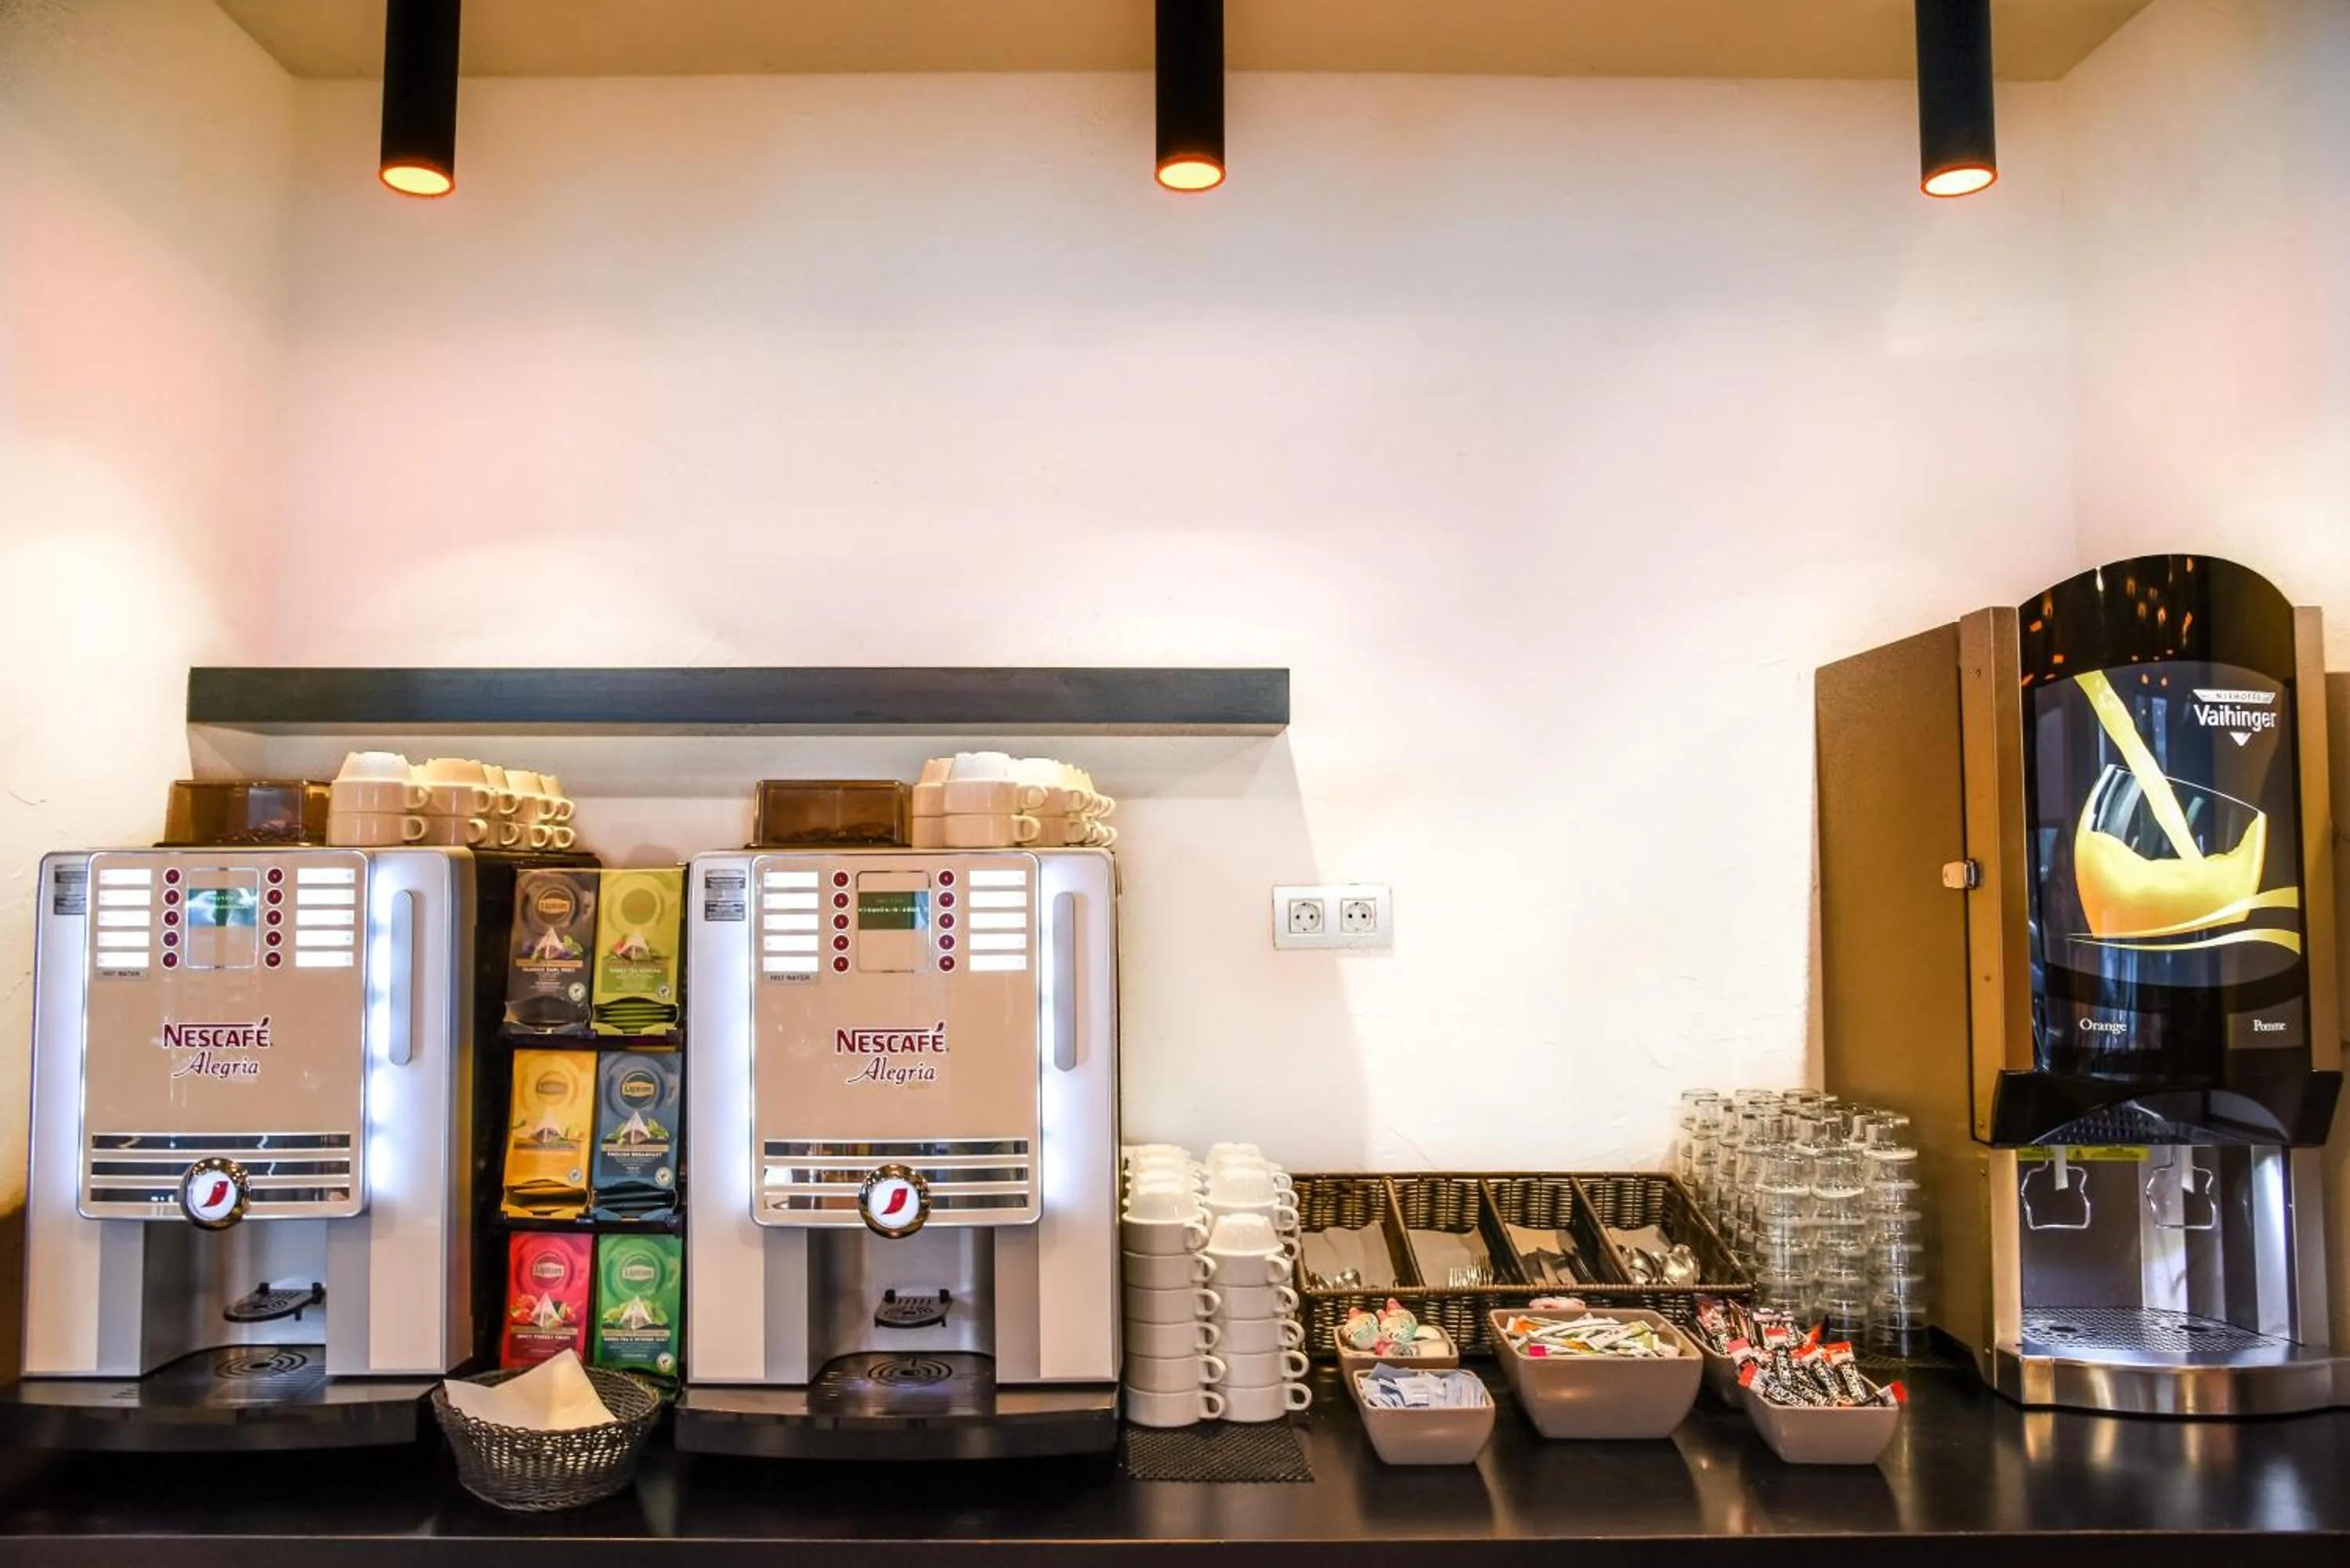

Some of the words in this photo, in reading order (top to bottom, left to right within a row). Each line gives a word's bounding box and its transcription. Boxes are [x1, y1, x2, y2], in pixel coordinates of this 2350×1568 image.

[2193, 704, 2277, 732] Vaihinger
[164, 1016, 269, 1048] NESCAFÉ
[837, 1021, 945, 1053] NESCAFÉ
[2080, 1018, 2128, 1034] Orange
[2253, 1019, 2287, 1031] Pomme
[172, 1050, 259, 1079] Alegria
[846, 1057, 936, 1085] Alegria
